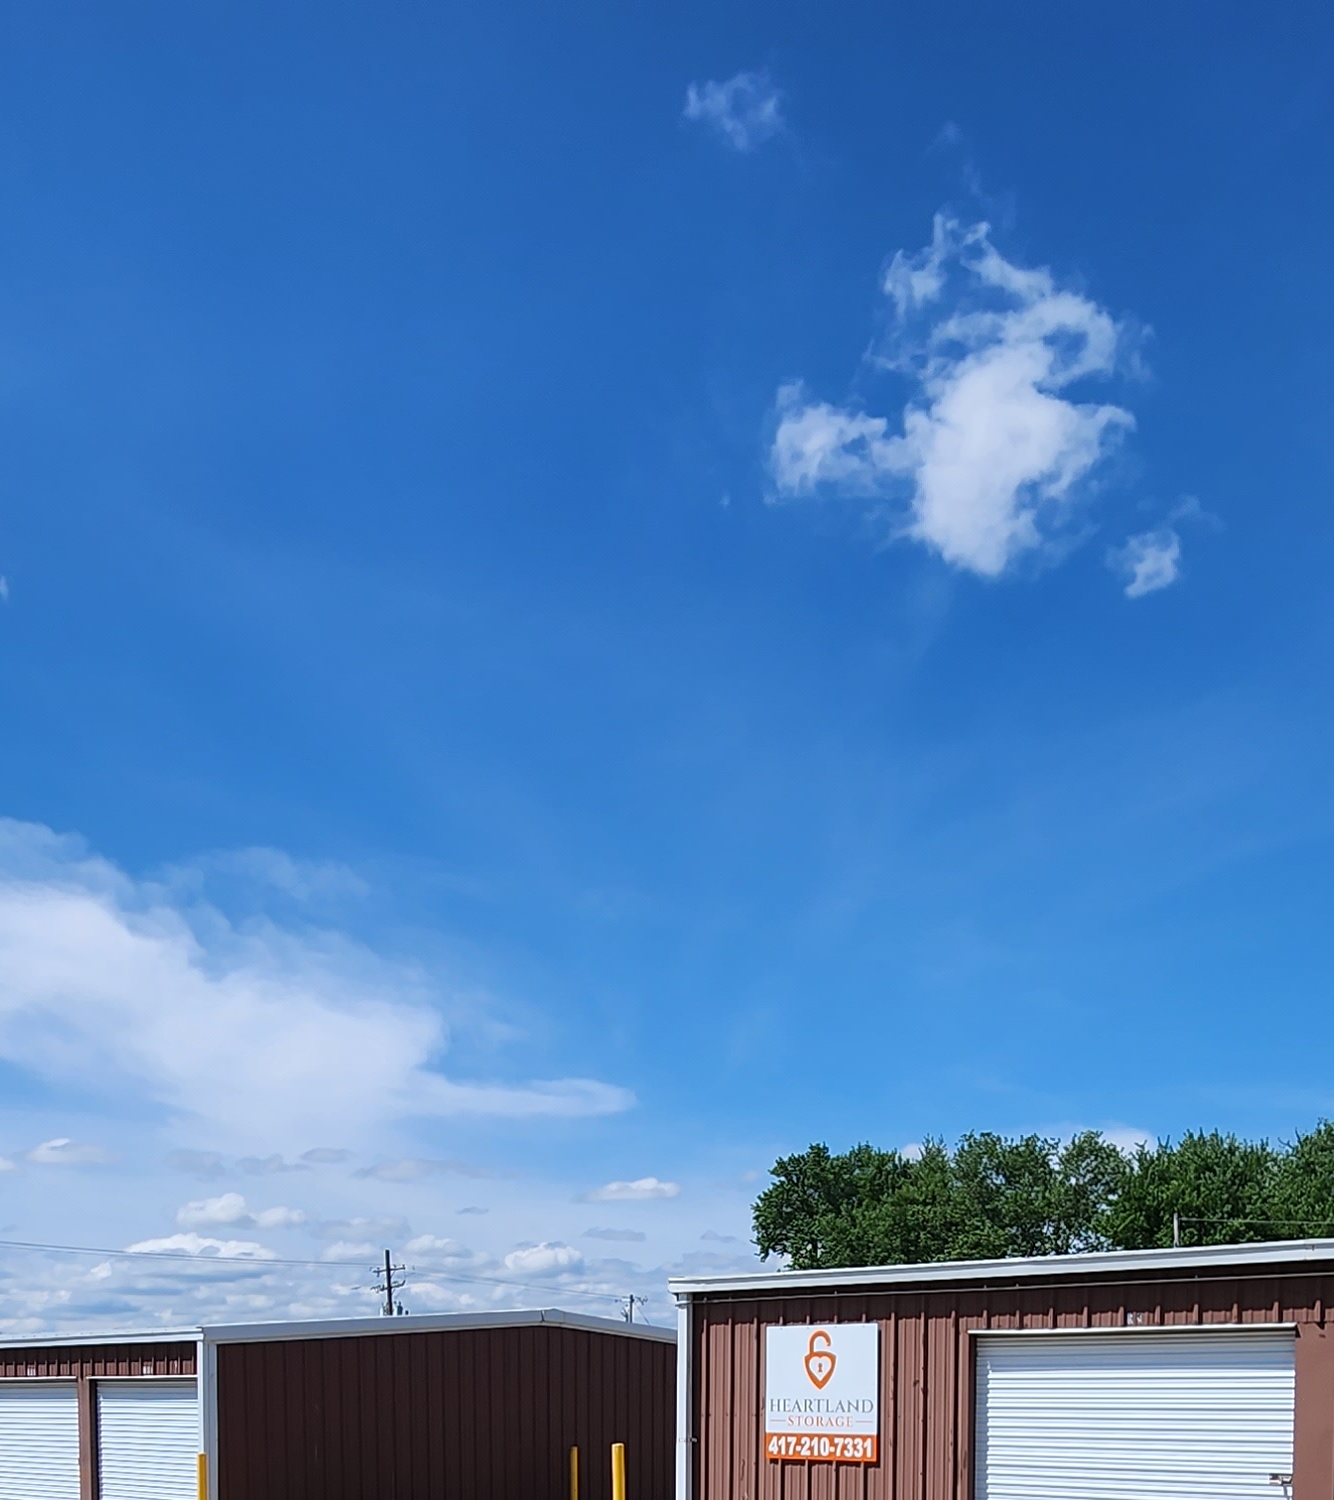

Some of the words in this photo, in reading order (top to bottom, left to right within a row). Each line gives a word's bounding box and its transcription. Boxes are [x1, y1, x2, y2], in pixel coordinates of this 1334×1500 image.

[769, 1398, 874, 1413] HEARTLAND
[787, 1416, 853, 1427] STORAGE
[768, 1435, 873, 1458] 417-210-7331
